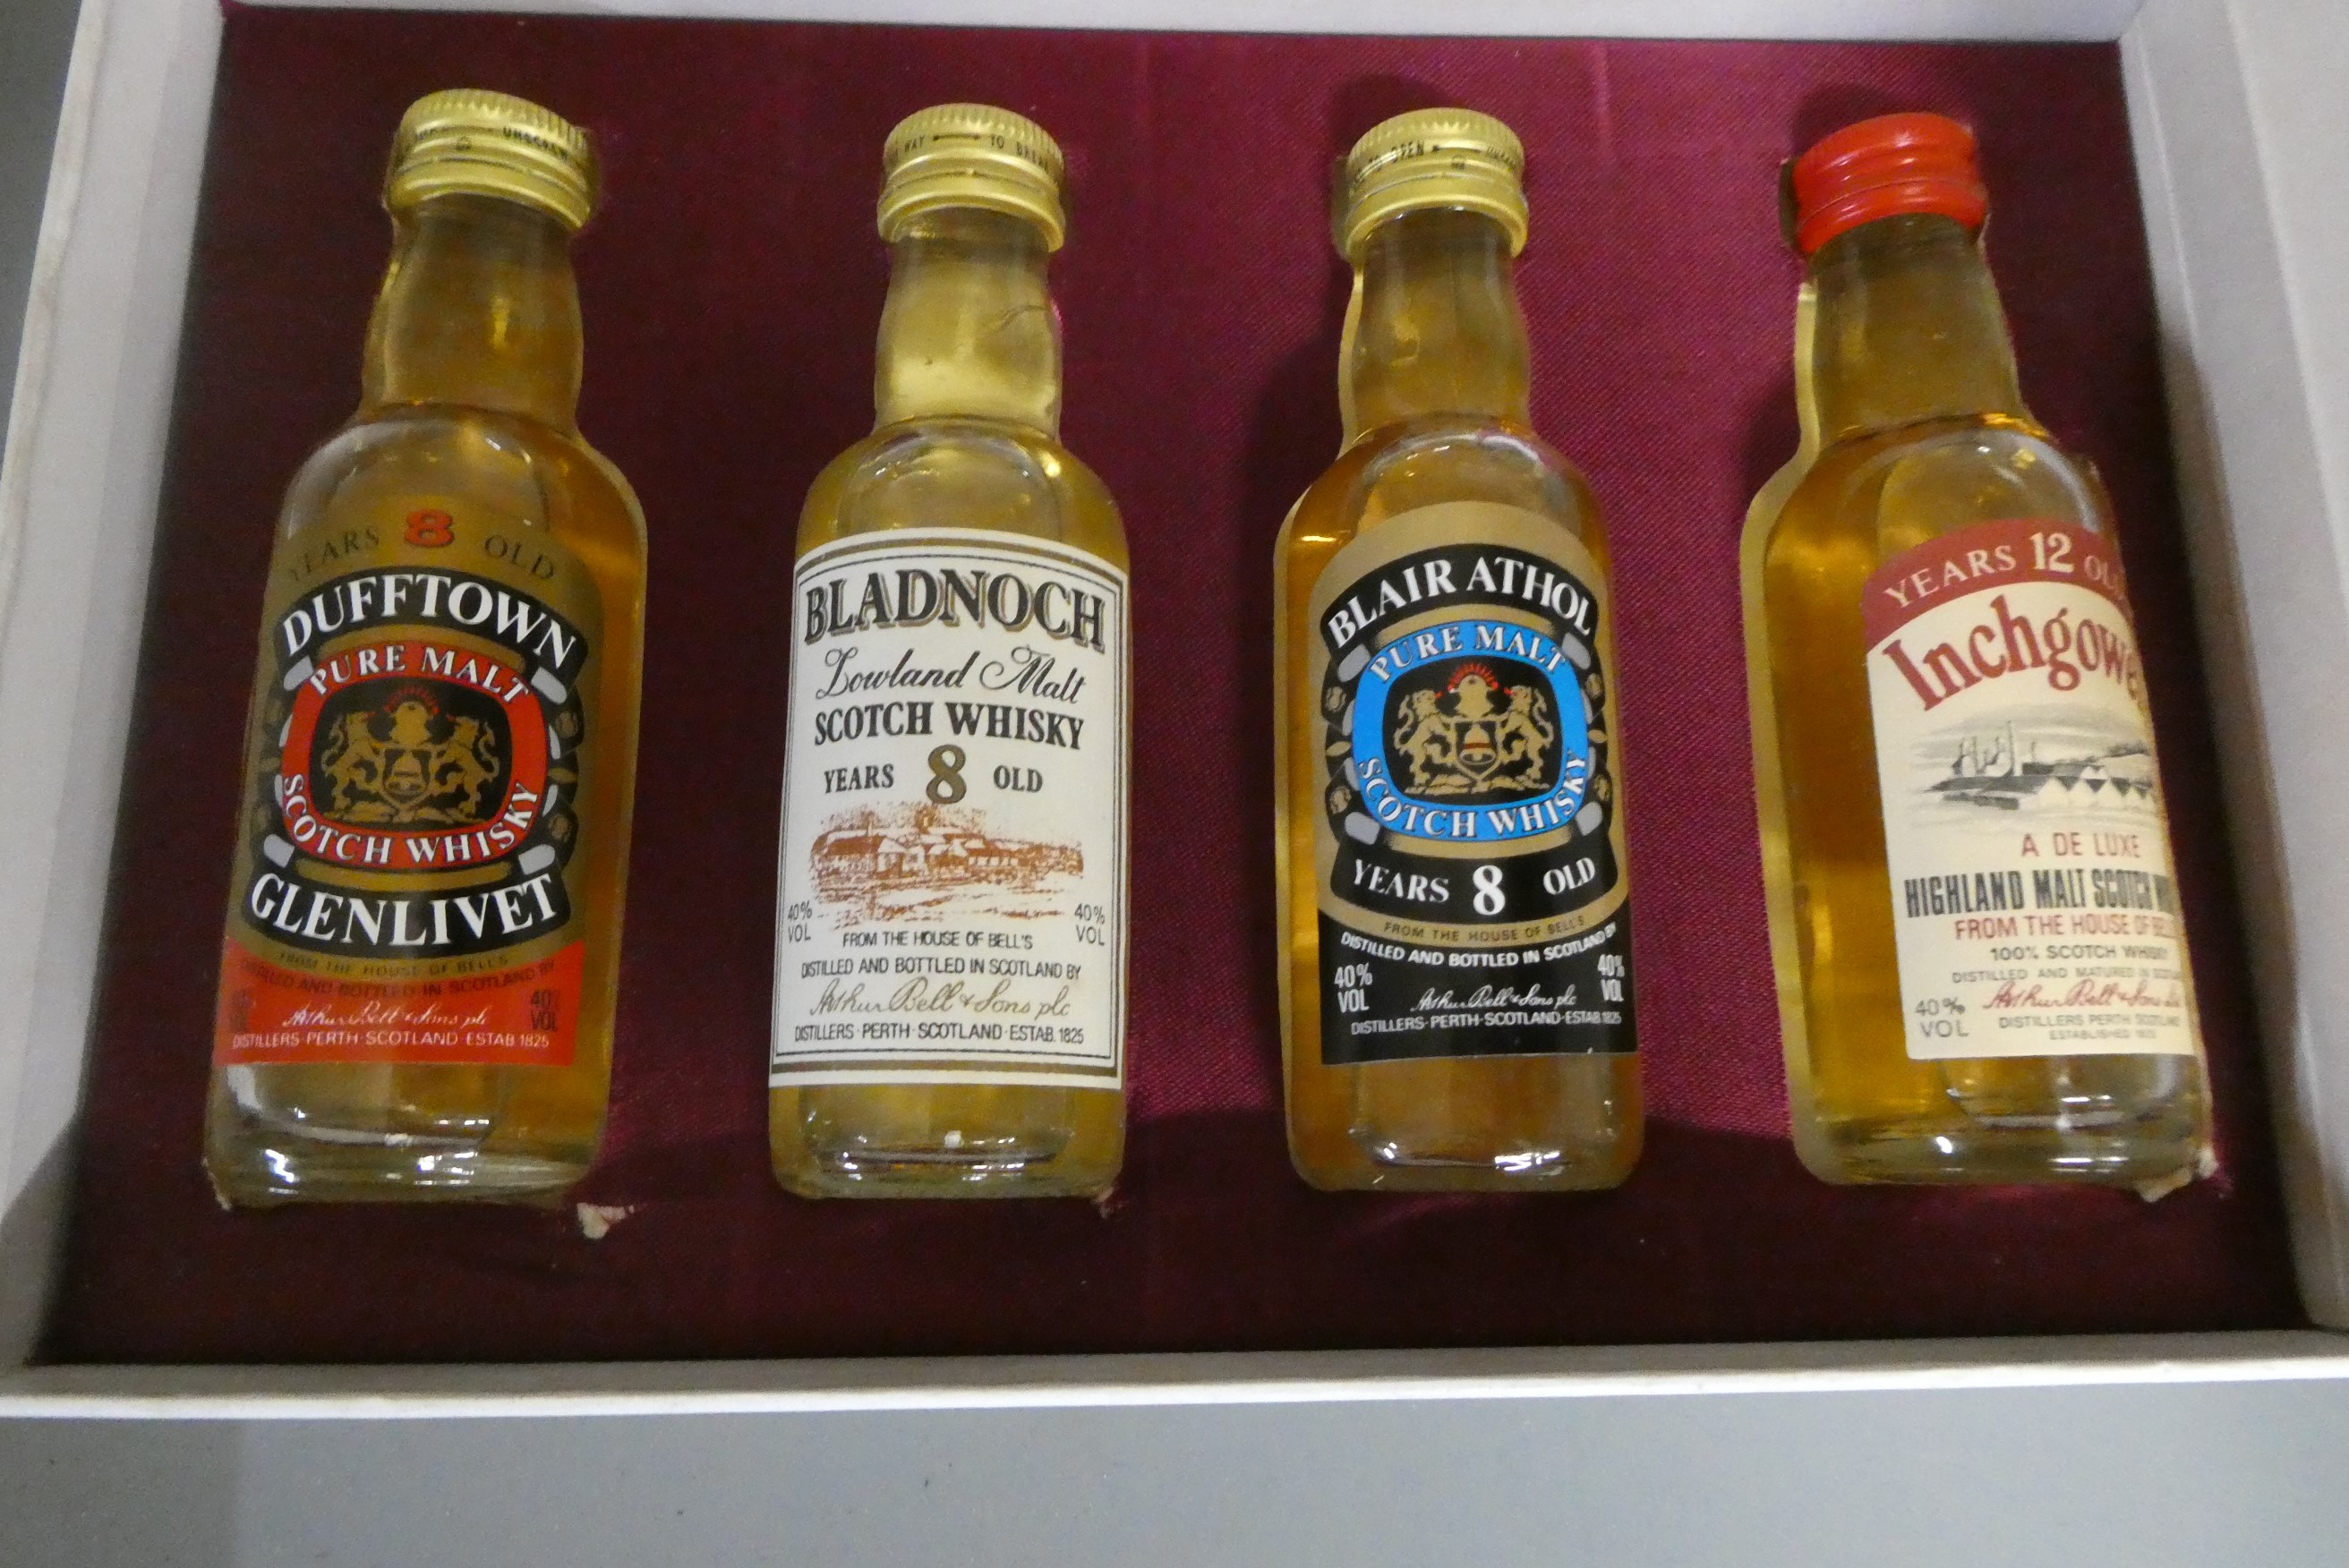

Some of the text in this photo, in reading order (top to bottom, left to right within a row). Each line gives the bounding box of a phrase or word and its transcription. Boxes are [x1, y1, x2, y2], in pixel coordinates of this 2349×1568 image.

[404, 507, 455, 549] 8
[484, 534, 555, 581] OLD
[1883, 544, 2018, 609] YEARS
[2029, 531, 2076, 575] 12
[804, 567, 1106, 655] BLADNOCH
[1328, 555, 1592, 649] BLAIR ATHOL
[282, 573, 577, 670] DUFFTOWN
[1370, 625, 1568, 684] PURE MALT
[308, 644, 532, 704] PURE MALT
[815, 644, 1087, 705] Lowland Malt
[814, 701, 1086, 751] SCOTCH WHISKY
[824, 744, 1045, 805] YEARS 8 OLD
[1358, 750, 1587, 839] SCOTCH WHISKY
[283, 773, 540, 865] SCOTCH WHISKY
[2020, 831, 2142, 858] A DE LUXE
[1352, 856, 1596, 916] YEARS 8 OLD
[1903, 869, 2026, 918] HIGHLAND
[2031, 868, 2087, 910] MALT
[250, 873, 558, 947] GLENLIVET
[788, 900, 813, 922] 40%
[1073, 902, 1106, 925] 40%
[788, 924, 812, 943] VOL
[842, 930, 1034, 950] FROM THE HOUSE OF BELL'S
[1075, 925, 1106, 946] VOL
[1383, 921, 1425, 939] FROM
[1432, 929, 1460, 942] THE
[1467, 928, 1518, 942] HOUSE
[1525, 926, 1542, 939] OF
[1954, 916, 2019, 941] FROM
[2024, 914, 2065, 937] THE
[2071, 912, 2131, 936] HOUSE
[1340, 931, 1406, 961] DISTILLED
[1407, 949, 1445, 967] AND
[1448, 952, 1520, 968] BOTTLED
[1522, 949, 1541, 965] IN
[1542, 930, 1606, 962] SCOTLAND
[1989, 944, 2040, 961] 100%
[2046, 944, 2117, 960] SCOTCH
[801, 956, 1082, 980] DISTILLED AND BOTTLED IN SCOTLAND BY
[1333, 961, 1374, 990] 40%
[1952, 967, 2029, 984] DISTILLED
[2037, 967, 2069, 979] AND
[809, 976, 886, 1016] Arthur
[882, 976, 966, 1012] Bell
[973, 978, 1031, 1014] Sons
[1033, 984, 1072, 1021] plc
[1337, 988, 1371, 1014] VOL
[1600, 977, 1626, 1003] VOL
[1914, 996, 1967, 1018] 40%
[1999, 1013, 2085, 1029] DISTILLERS
[794, 1022, 855, 1043] DISTILLERS
[861, 1022, 910, 1040] PERTH
[918, 1021, 1003, 1040] SCOTLAND
[1059, 1027, 1085, 1044] 1825
[1350, 1015, 1425, 1036] DISTILLERS
[1430, 1012, 1480, 1029] PERTH
[1483, 1010, 1561, 1027] SCOTLAND
[1920, 1018, 1969, 1038] VOL
[232, 1031, 300, 1050] DISTILLERS
[306, 1030, 359, 1046] PERTH
[365, 1029, 459, 1047] SCOTLAND
[519, 1033, 550, 1049] 1825
